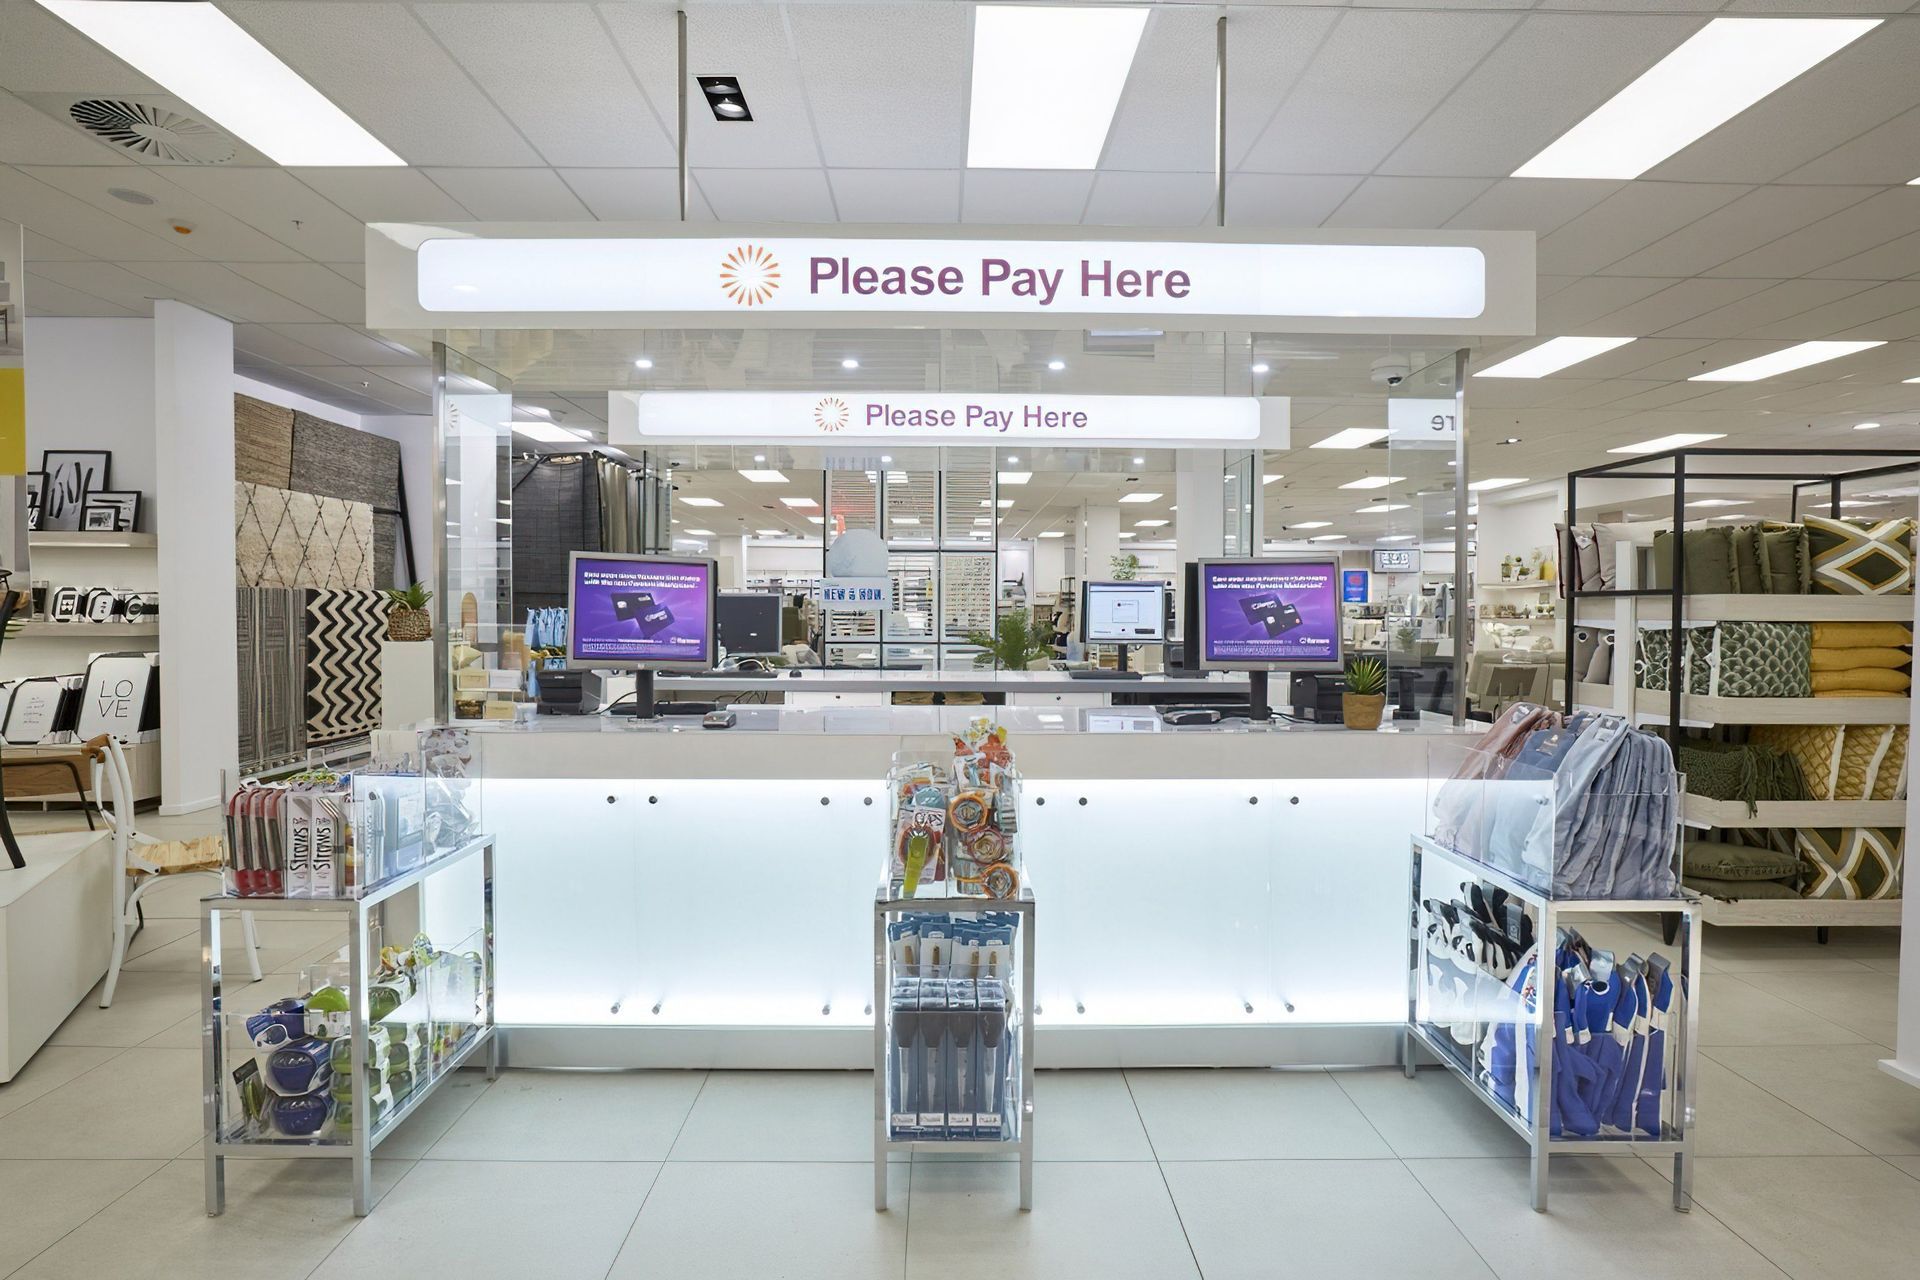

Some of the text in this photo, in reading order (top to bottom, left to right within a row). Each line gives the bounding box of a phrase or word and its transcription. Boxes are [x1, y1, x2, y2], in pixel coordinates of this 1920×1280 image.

[810, 256, 1191, 306] Please Pay Here
[866, 403, 1088, 433] Please Pay Here
[100, 679, 134, 698] LO
[98, 699, 131, 718] VE
